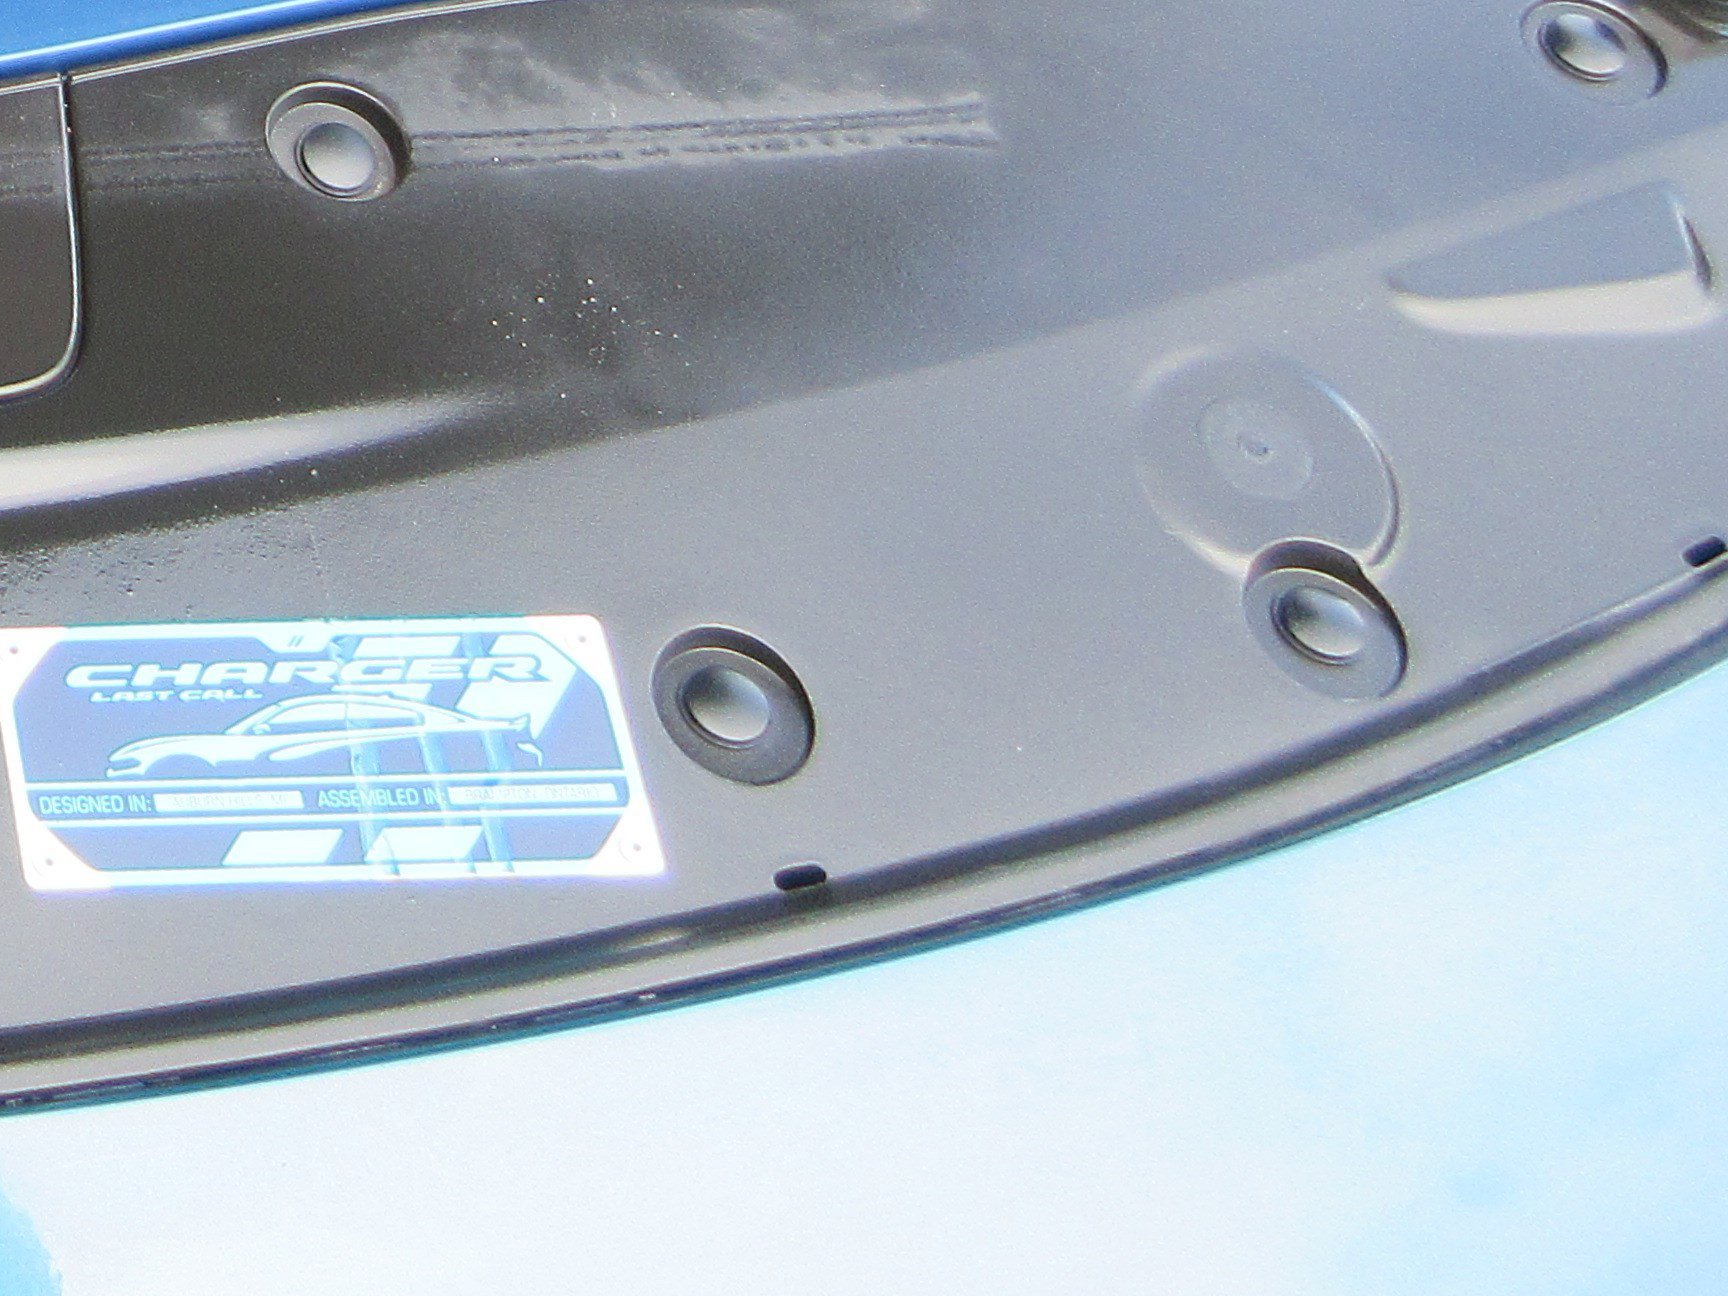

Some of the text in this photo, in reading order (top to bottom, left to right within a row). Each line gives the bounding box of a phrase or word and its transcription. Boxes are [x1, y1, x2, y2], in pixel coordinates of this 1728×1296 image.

[64, 655, 552, 688] CHARGER
[89, 688, 264, 703] LAST CALL
[38, 793, 124, 815] DESIGNED
[127, 793, 152, 813] IN:
[317, 786, 419, 808] ASSEMBLED
